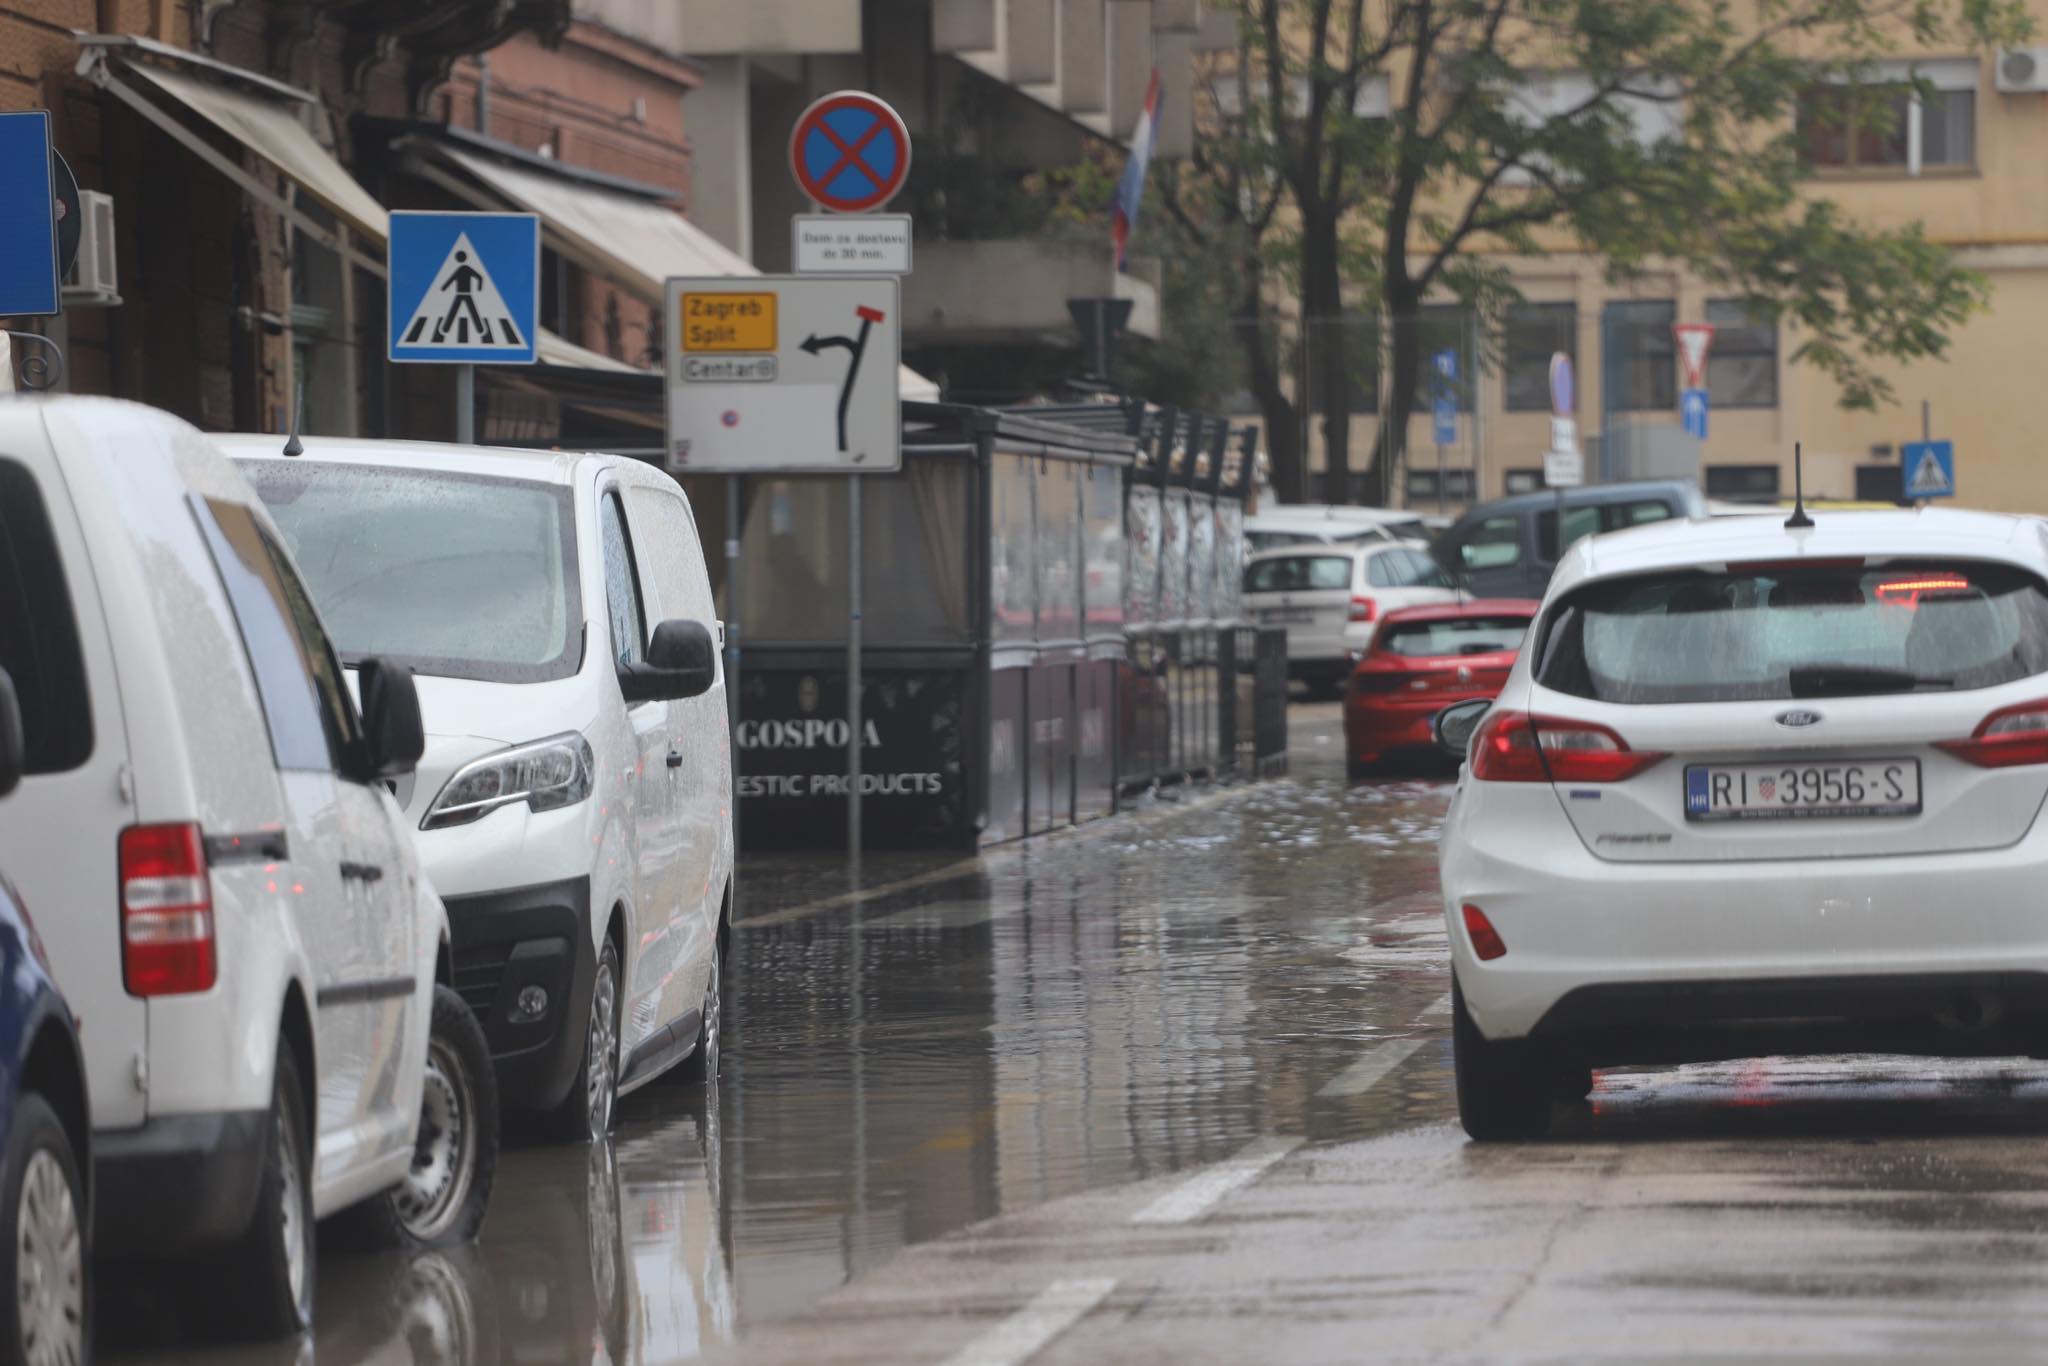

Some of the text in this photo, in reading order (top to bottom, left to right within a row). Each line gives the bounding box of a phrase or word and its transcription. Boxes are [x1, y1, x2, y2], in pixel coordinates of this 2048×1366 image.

[688, 298, 763, 321] Zagreb
[688, 324, 736, 346] Split
[687, 359, 755, 378] Centar
[735, 717, 882, 749] GOSPOA
[1711, 770, 1748, 807] RI
[1779, 765, 1904, 805] 3956-S
